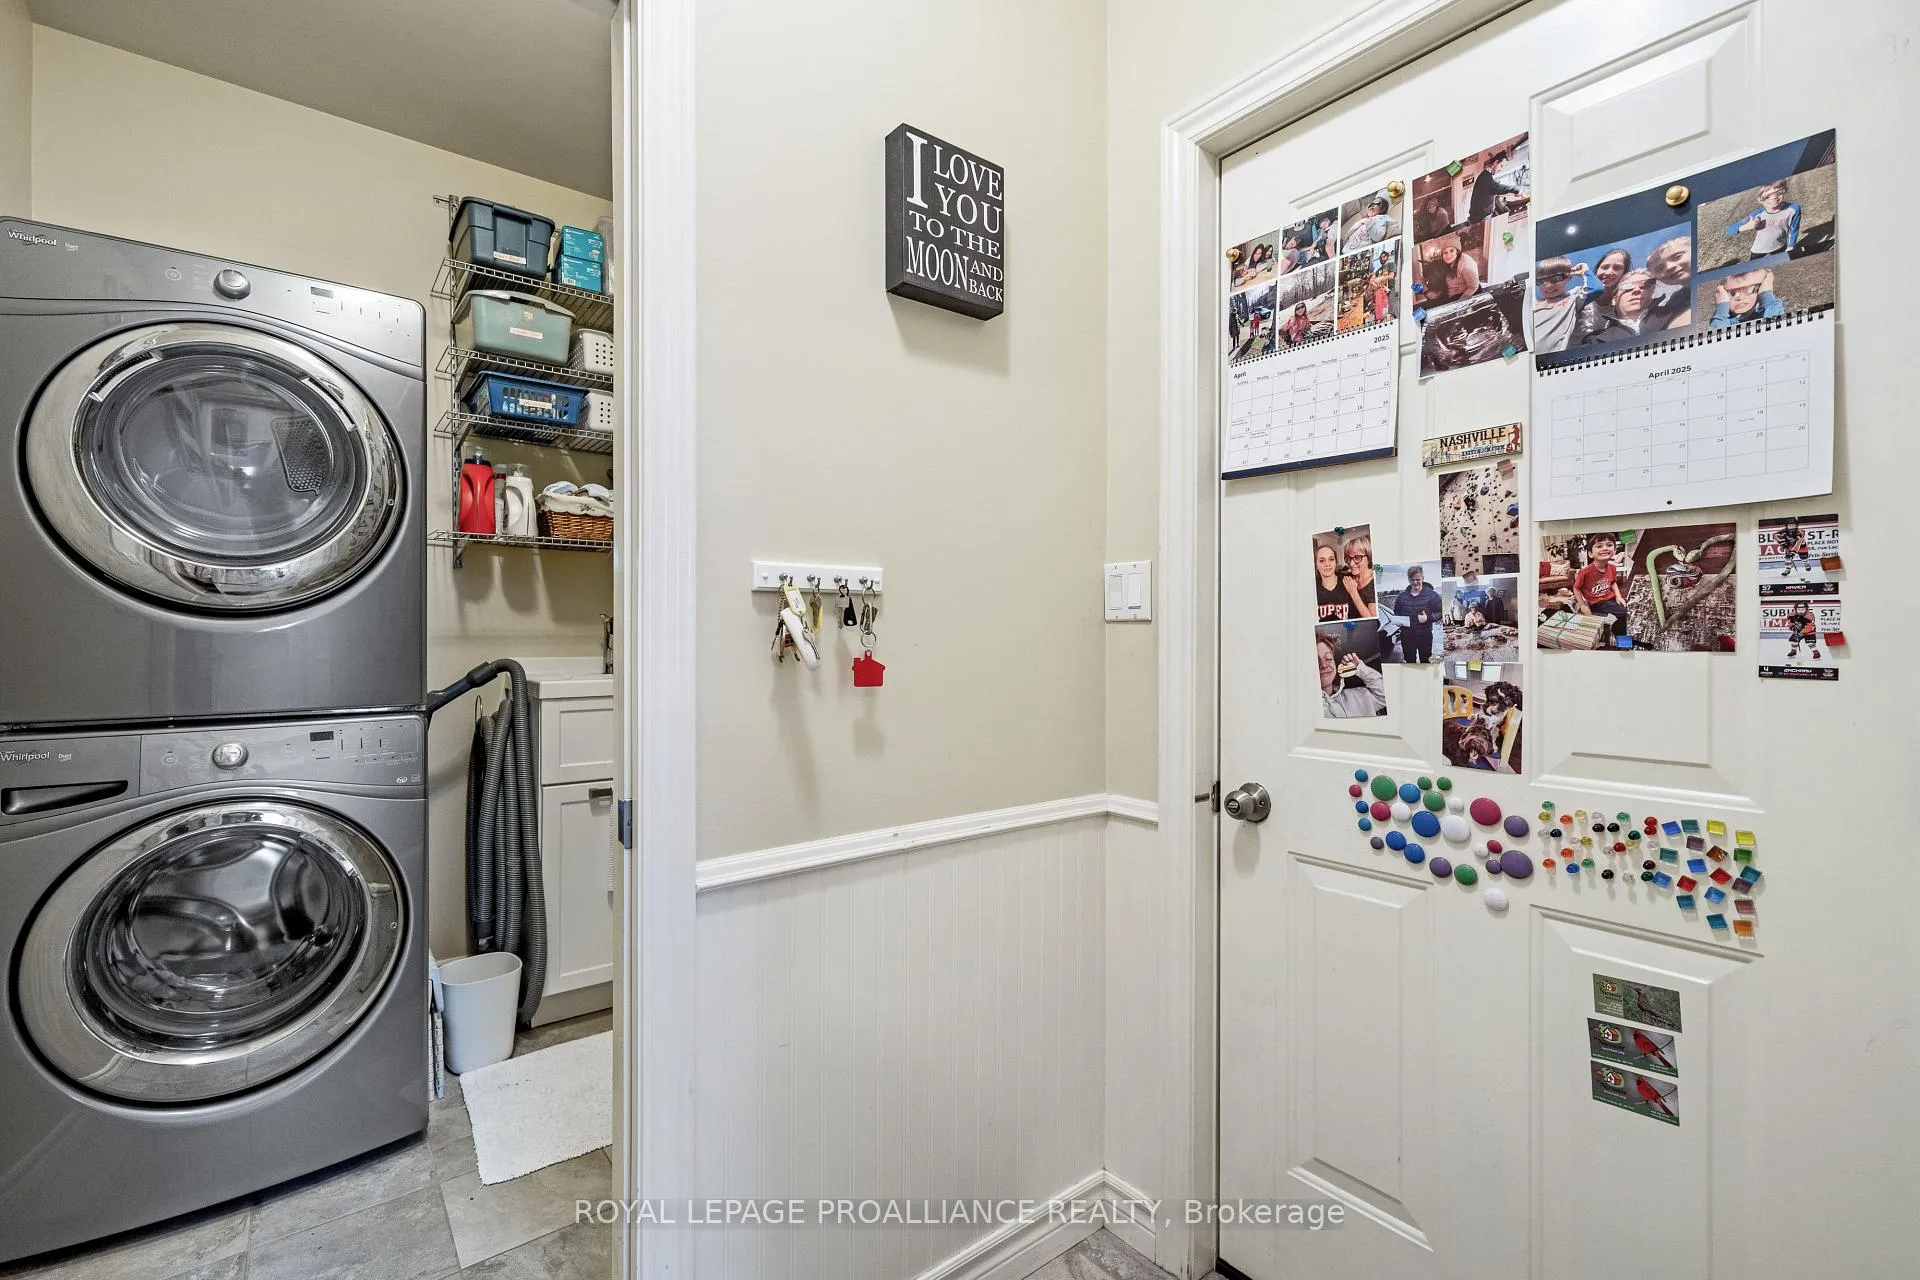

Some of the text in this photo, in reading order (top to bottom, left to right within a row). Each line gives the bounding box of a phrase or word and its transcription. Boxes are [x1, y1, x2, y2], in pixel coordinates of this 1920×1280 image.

[906, 131, 928, 209] I
[933, 144, 1003, 201] LOVE
[934, 182, 1002, 234] YOU
[8, 231, 56, 246] Whirlpool
[908, 210, 1000, 260] TO THE
[906, 236, 969, 292] MOON
[970, 260, 1003, 282] AND
[969, 278, 1003, 302] BACK
[1374, 334, 1390, 344] 2025
[1234, 372, 1246, 380] April
[1648, 365, 1692, 379] April 2025
[1440, 426, 1506, 448] NASHVILLE
[1318, 603, 1348, 620] UPER
[0, 752, 50, 762] Whirlpool
